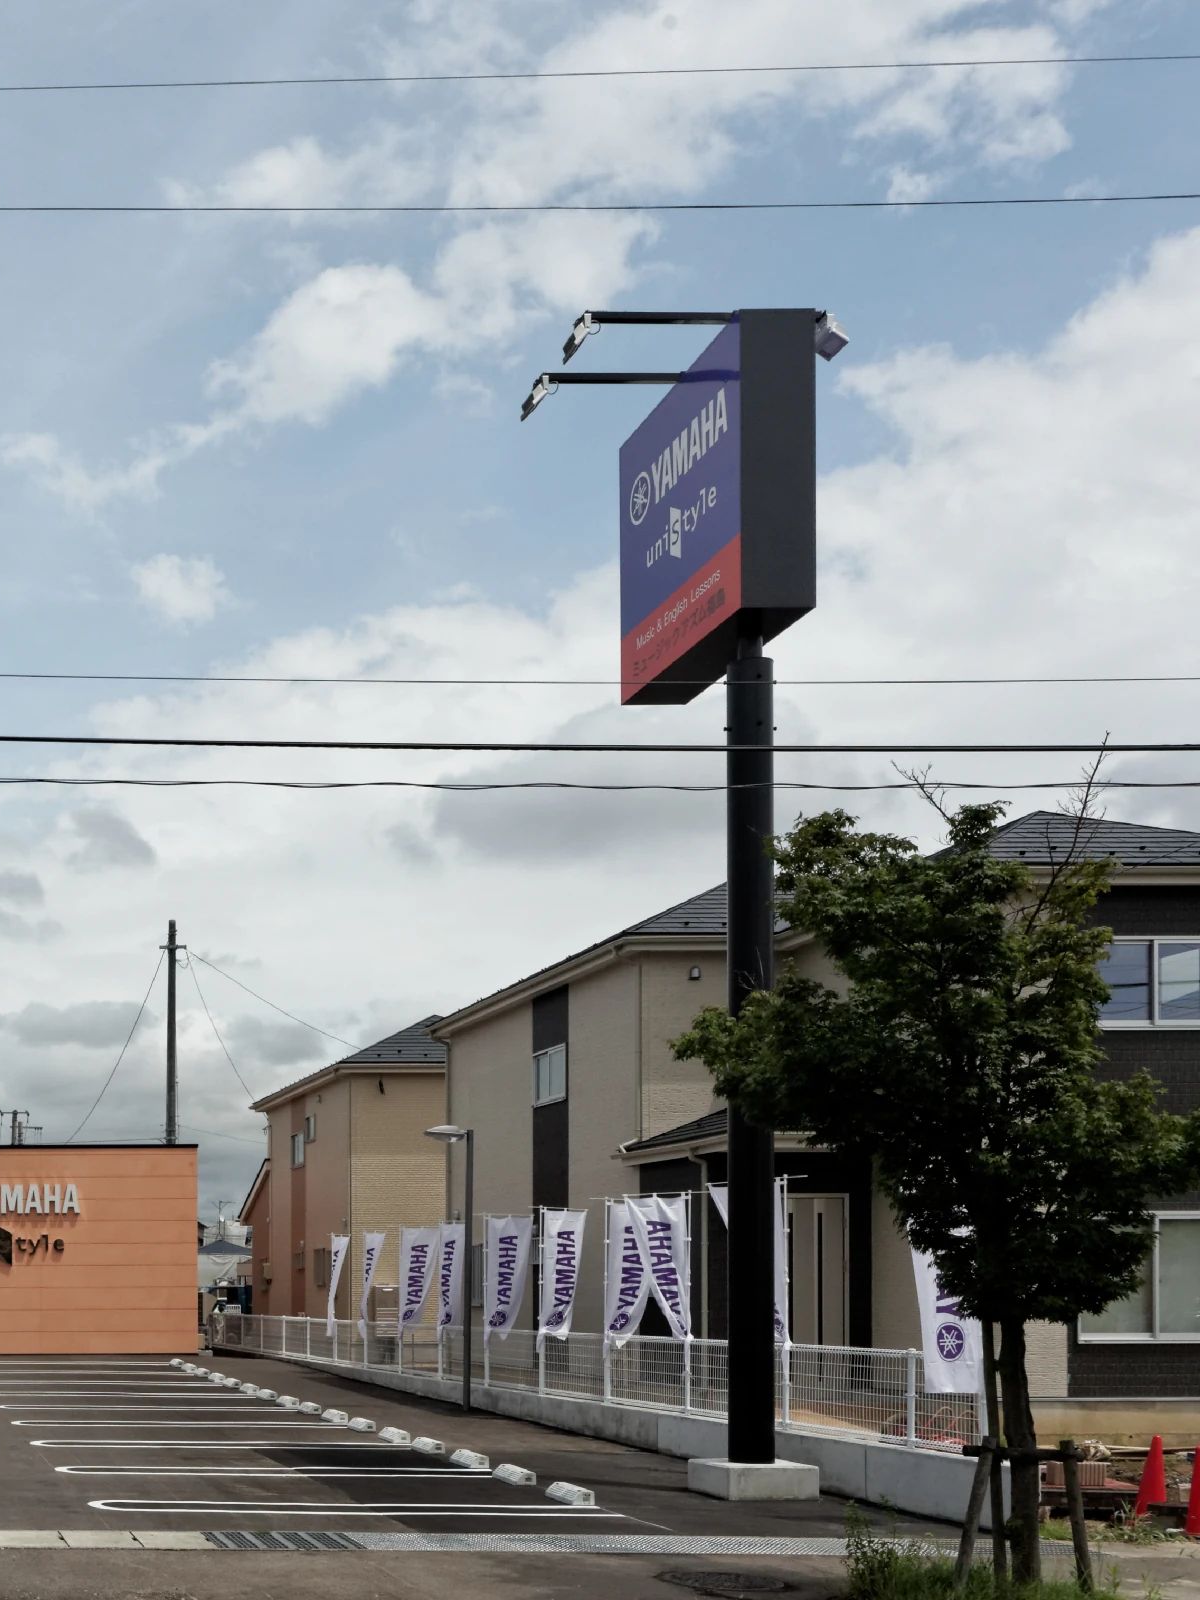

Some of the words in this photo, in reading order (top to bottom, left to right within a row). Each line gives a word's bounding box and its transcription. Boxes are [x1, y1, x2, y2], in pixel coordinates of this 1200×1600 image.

[651, 387, 728, 504] YAMAHA
[636, 627, 655, 650] Music
[656, 617, 663, 632] &
[664, 598, 688, 624] English
[690, 569, 721, 603] Lessons
[405, 1243, 429, 1307] YAMAHA
[441, 1239, 456, 1307] YAMAHA
[497, 1235, 519, 1307] YAMAHA
[553, 1230, 576, 1308] YAMAHA
